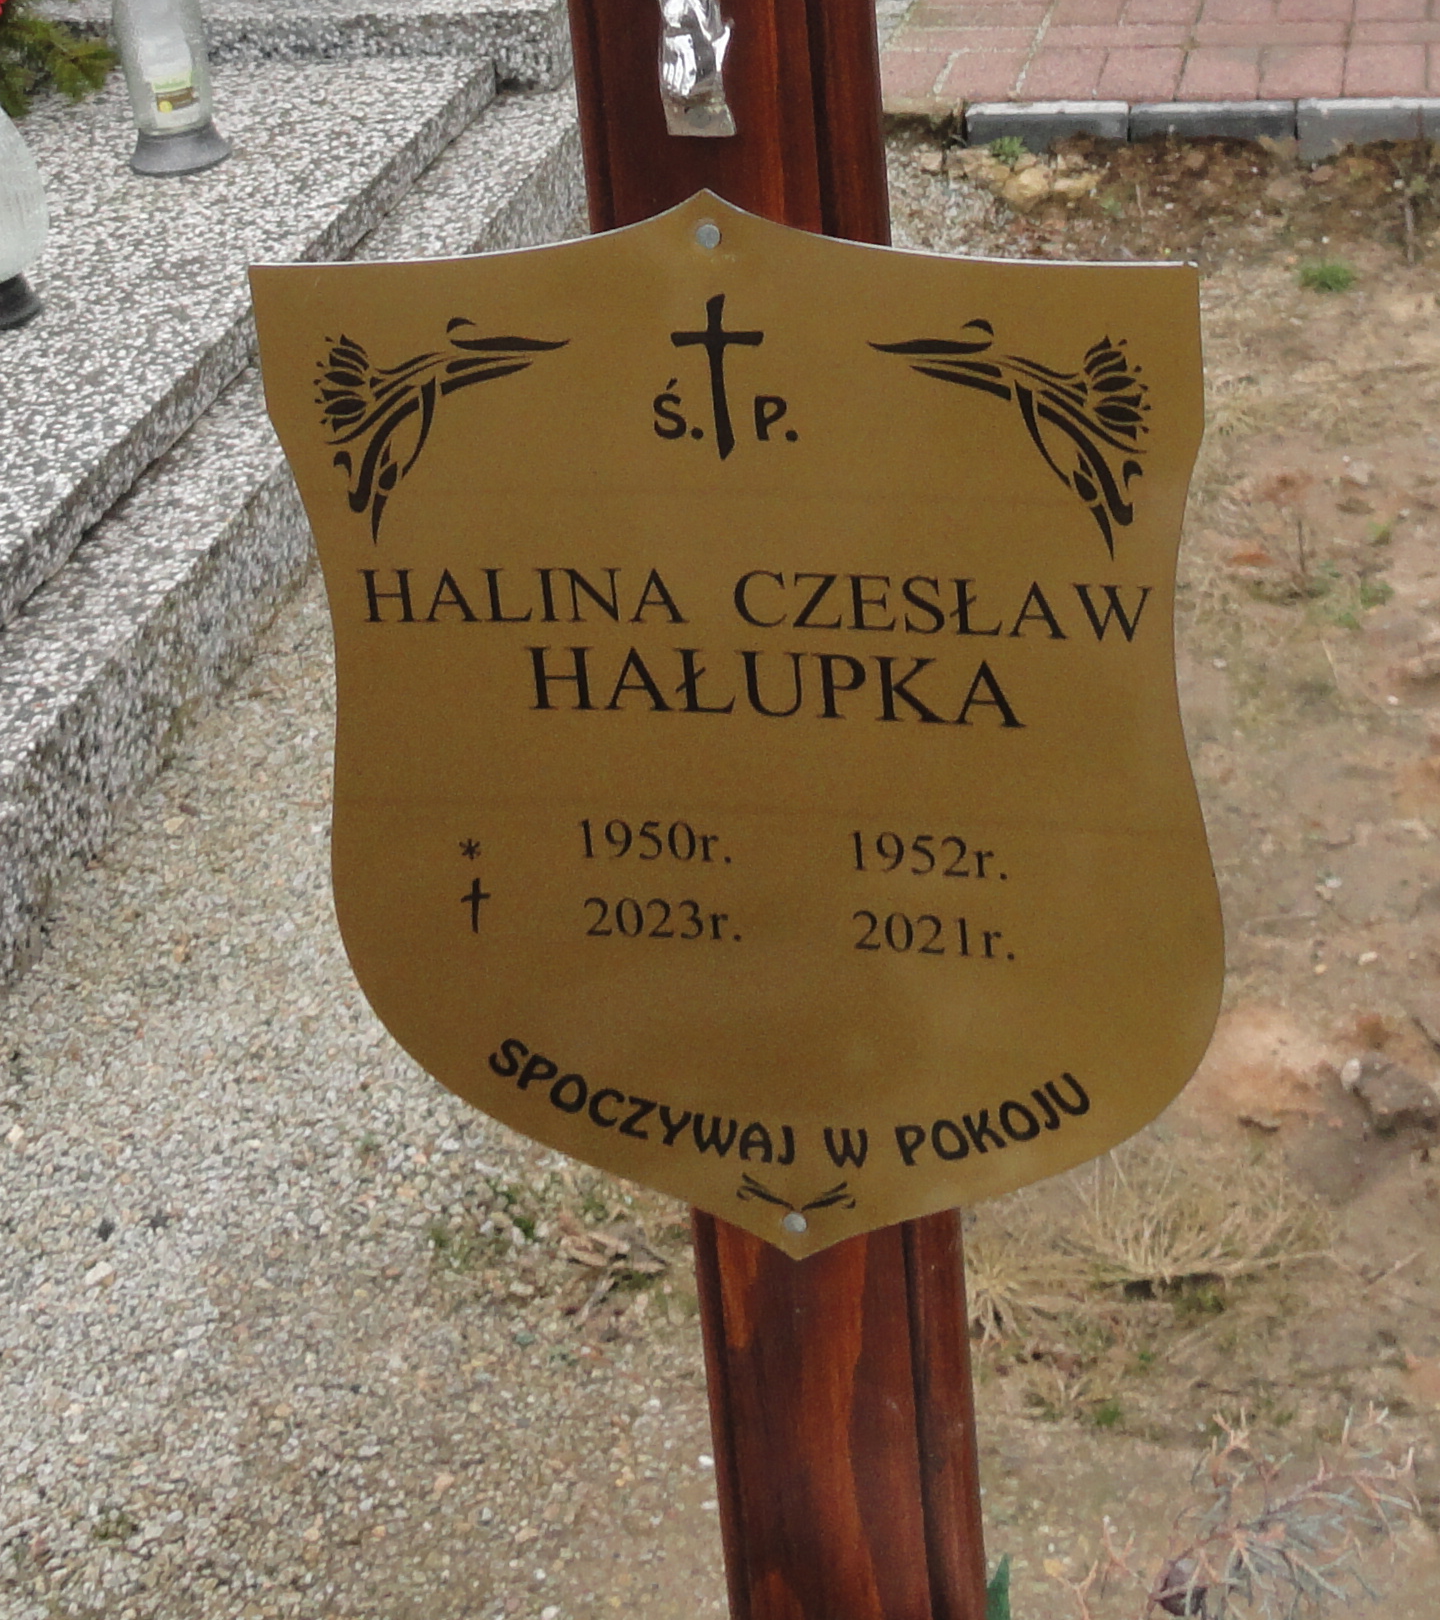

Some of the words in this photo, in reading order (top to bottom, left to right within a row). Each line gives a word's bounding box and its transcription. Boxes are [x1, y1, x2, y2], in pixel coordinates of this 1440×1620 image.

[359, 566, 689, 626] HALINA
[732, 568, 1152, 644] CZESŁAW
[525, 644, 1029, 730] HAŁUPKA
[580, 818, 733, 867] 1950r.
[849, 829, 1010, 882] 1952r.
[584, 896, 743, 943] 2023r.
[851, 909, 1017, 962] 2021r.
[487, 1036, 798, 1165] SPOCZYWAJ
[823, 1127, 869, 1168] W
[896, 1072, 1092, 1168] POKOJU
